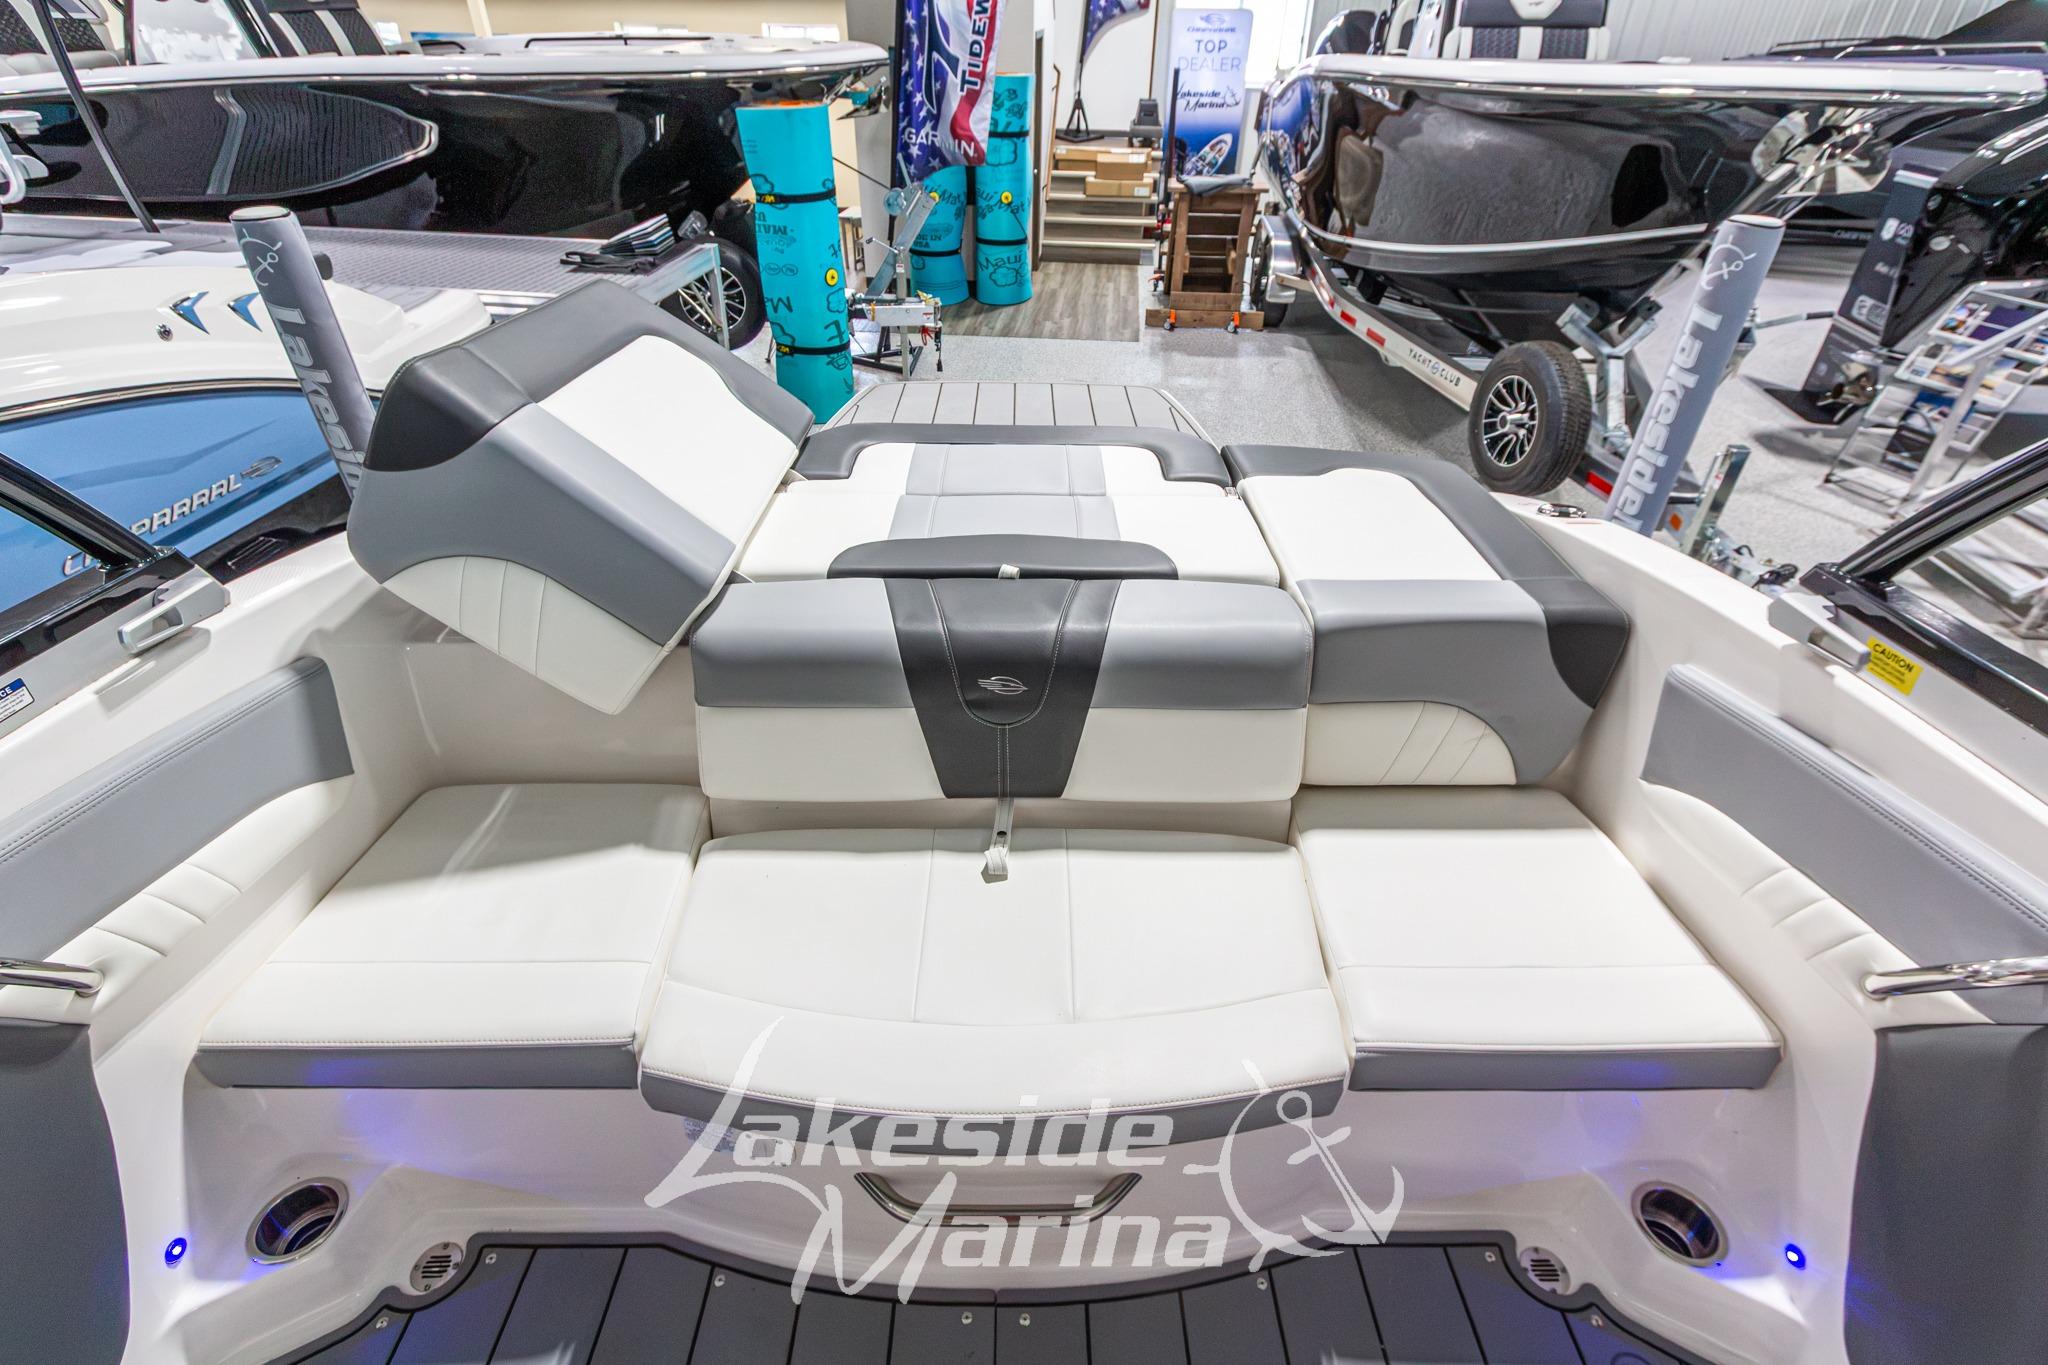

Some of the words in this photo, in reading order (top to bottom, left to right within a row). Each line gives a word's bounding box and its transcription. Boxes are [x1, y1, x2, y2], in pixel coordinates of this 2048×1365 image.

[1195, 39, 1228, 54] TOP
[1178, 56, 1242, 72] DEALER
[1184, 97, 1225, 112] Marina
[1408, 347, 1433, 368] YACHT
[1440, 368, 1461, 387] CLUB
[1872, 643, 1915, 673] CAUTION
